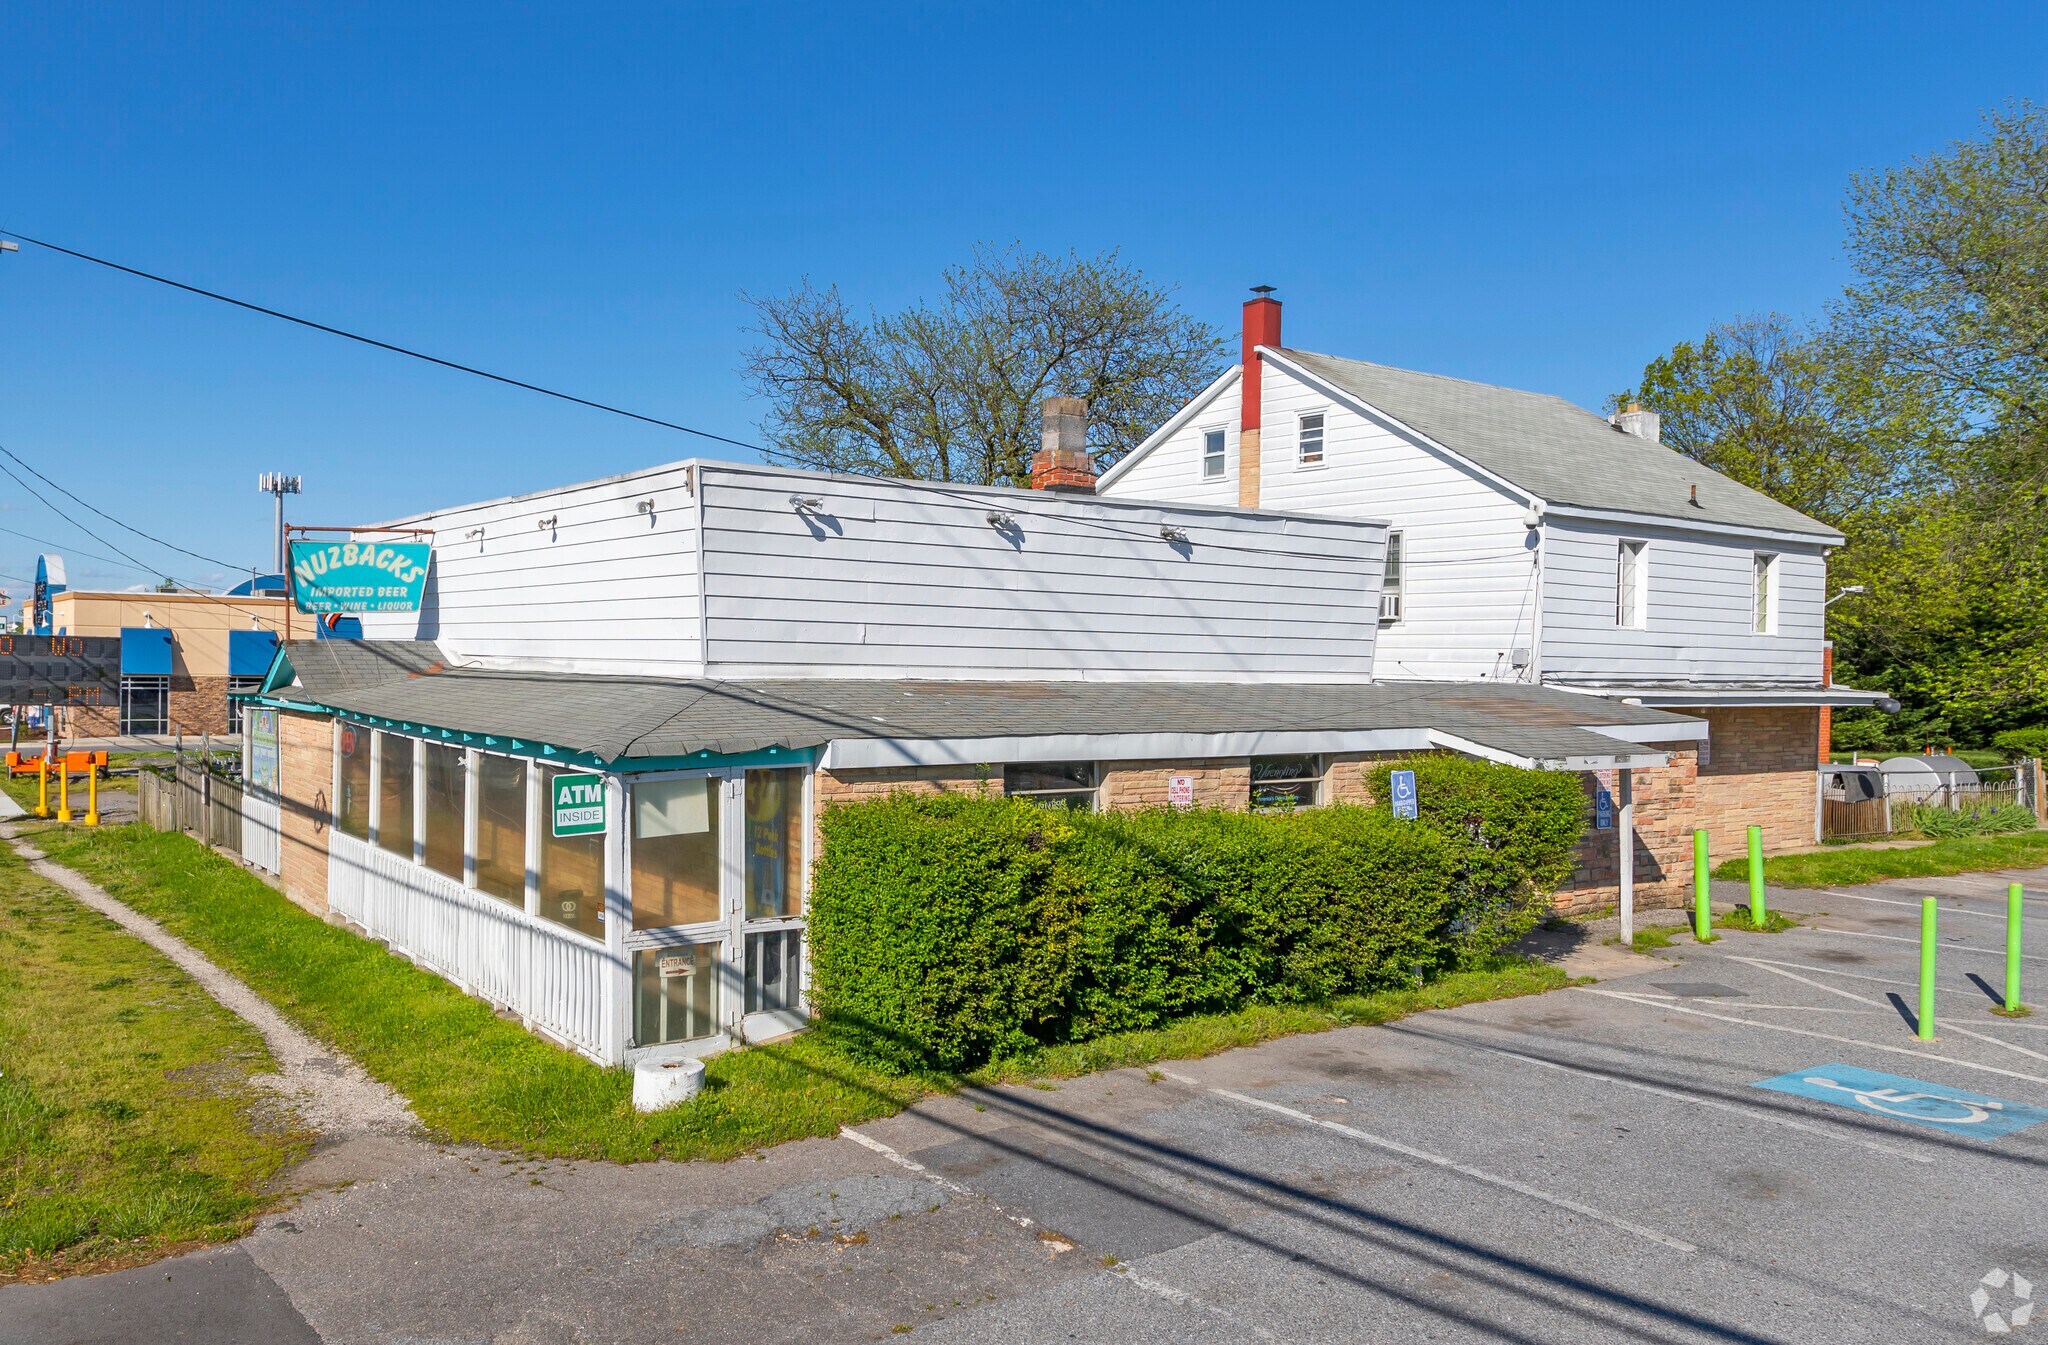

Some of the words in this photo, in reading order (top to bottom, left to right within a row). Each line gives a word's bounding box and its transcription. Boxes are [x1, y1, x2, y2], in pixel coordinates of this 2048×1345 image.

[294, 543, 425, 588] NUZBACKS
[310, 586, 374, 597] IMPORTED
[377, 586, 408, 597] BEER
[305, 601, 331, 611] BEER
[340, 601, 367, 611] WINE
[377, 601, 413, 611] LIQUOR
[68, 685, 100, 704] PM
[1253, 763, 1302, 780] Yuengling
[558, 784, 601, 805] ATM
[1171, 786, 1179, 794] CELL
[559, 810, 600, 822] INSIDE
[662, 957, 695, 968] ENTRANCE
